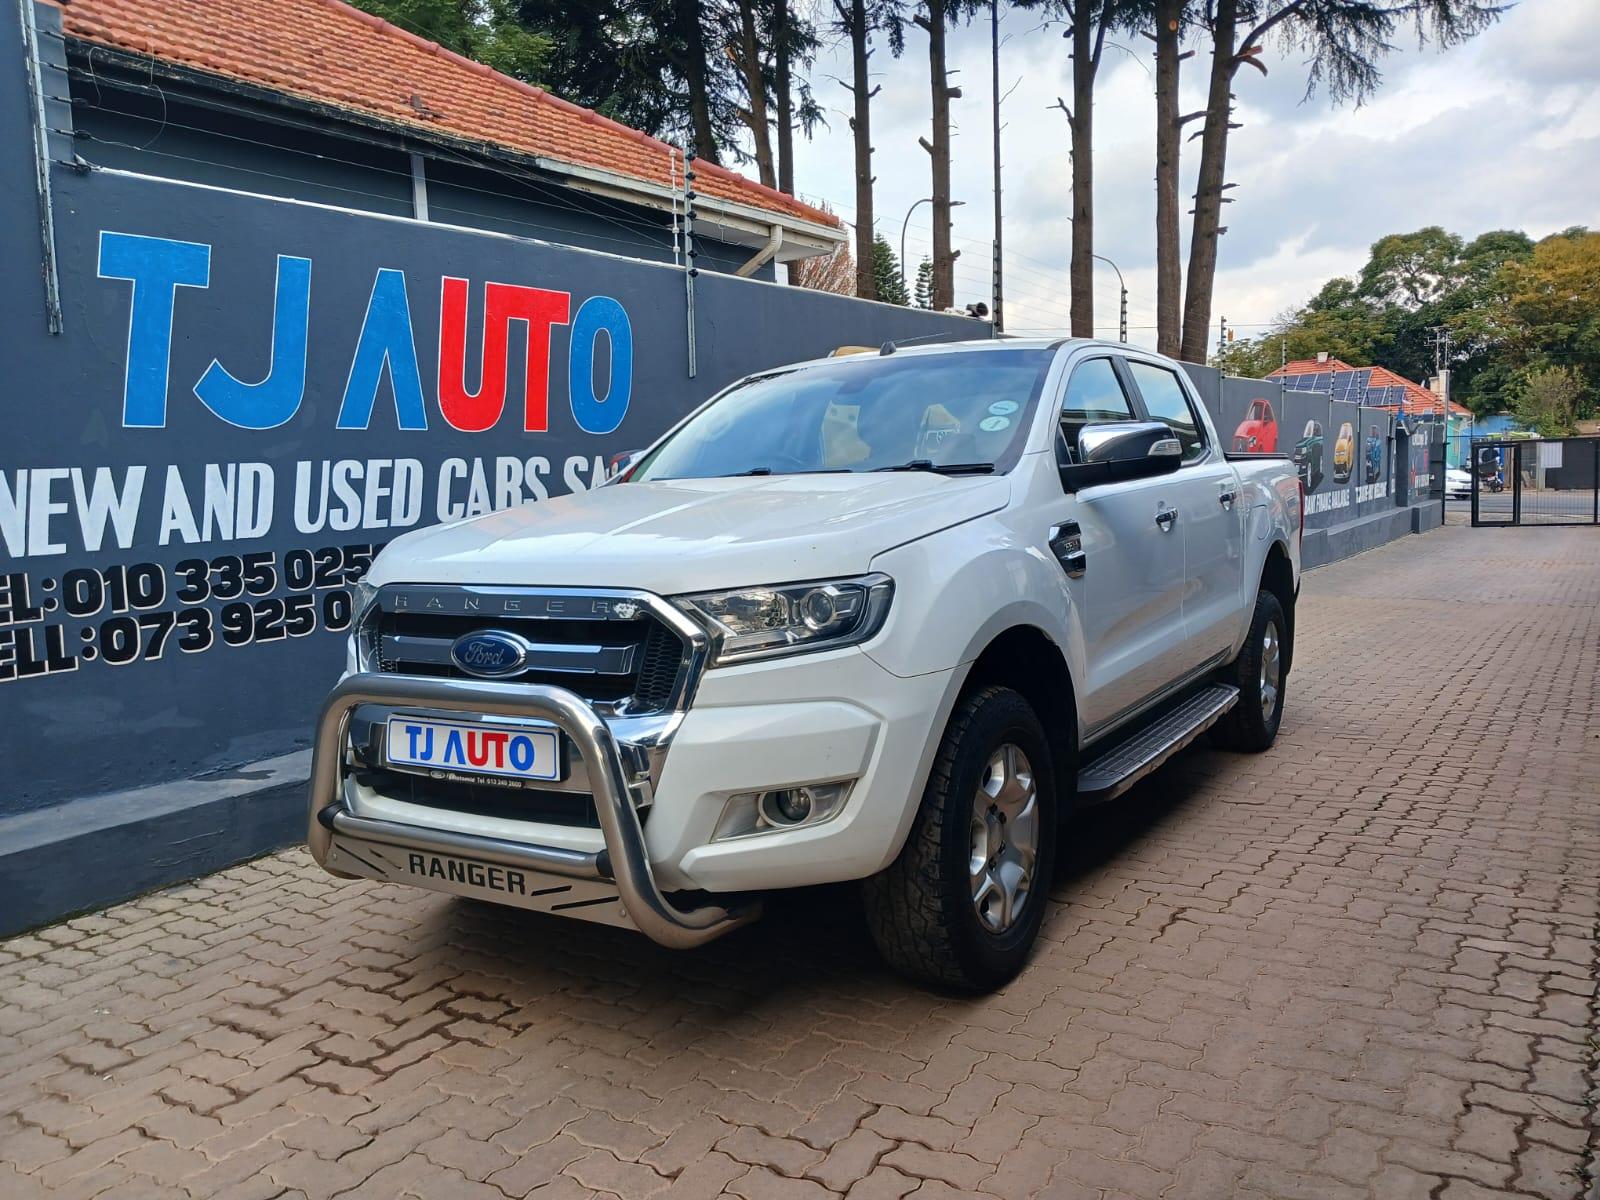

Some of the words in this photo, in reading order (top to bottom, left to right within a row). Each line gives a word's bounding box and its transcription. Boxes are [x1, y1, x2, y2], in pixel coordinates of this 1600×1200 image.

[97, 230, 312, 430] TJ
[335, 268, 633, 434] AUTO
[0, 465, 147, 558] NEW
[158, 462, 275, 546] AND
[293, 458, 424, 534] USED
[436, 456, 551, 523] CARS
[174, 551, 277, 605] 335
[221, 594, 317, 647] 925
[394, 594, 612, 614] RANGER
[464, 641, 505, 665] Ford
[405, 725, 434, 761] TJ
[443, 730, 535, 771] AUTO
[408, 853, 526, 895] RANGER
